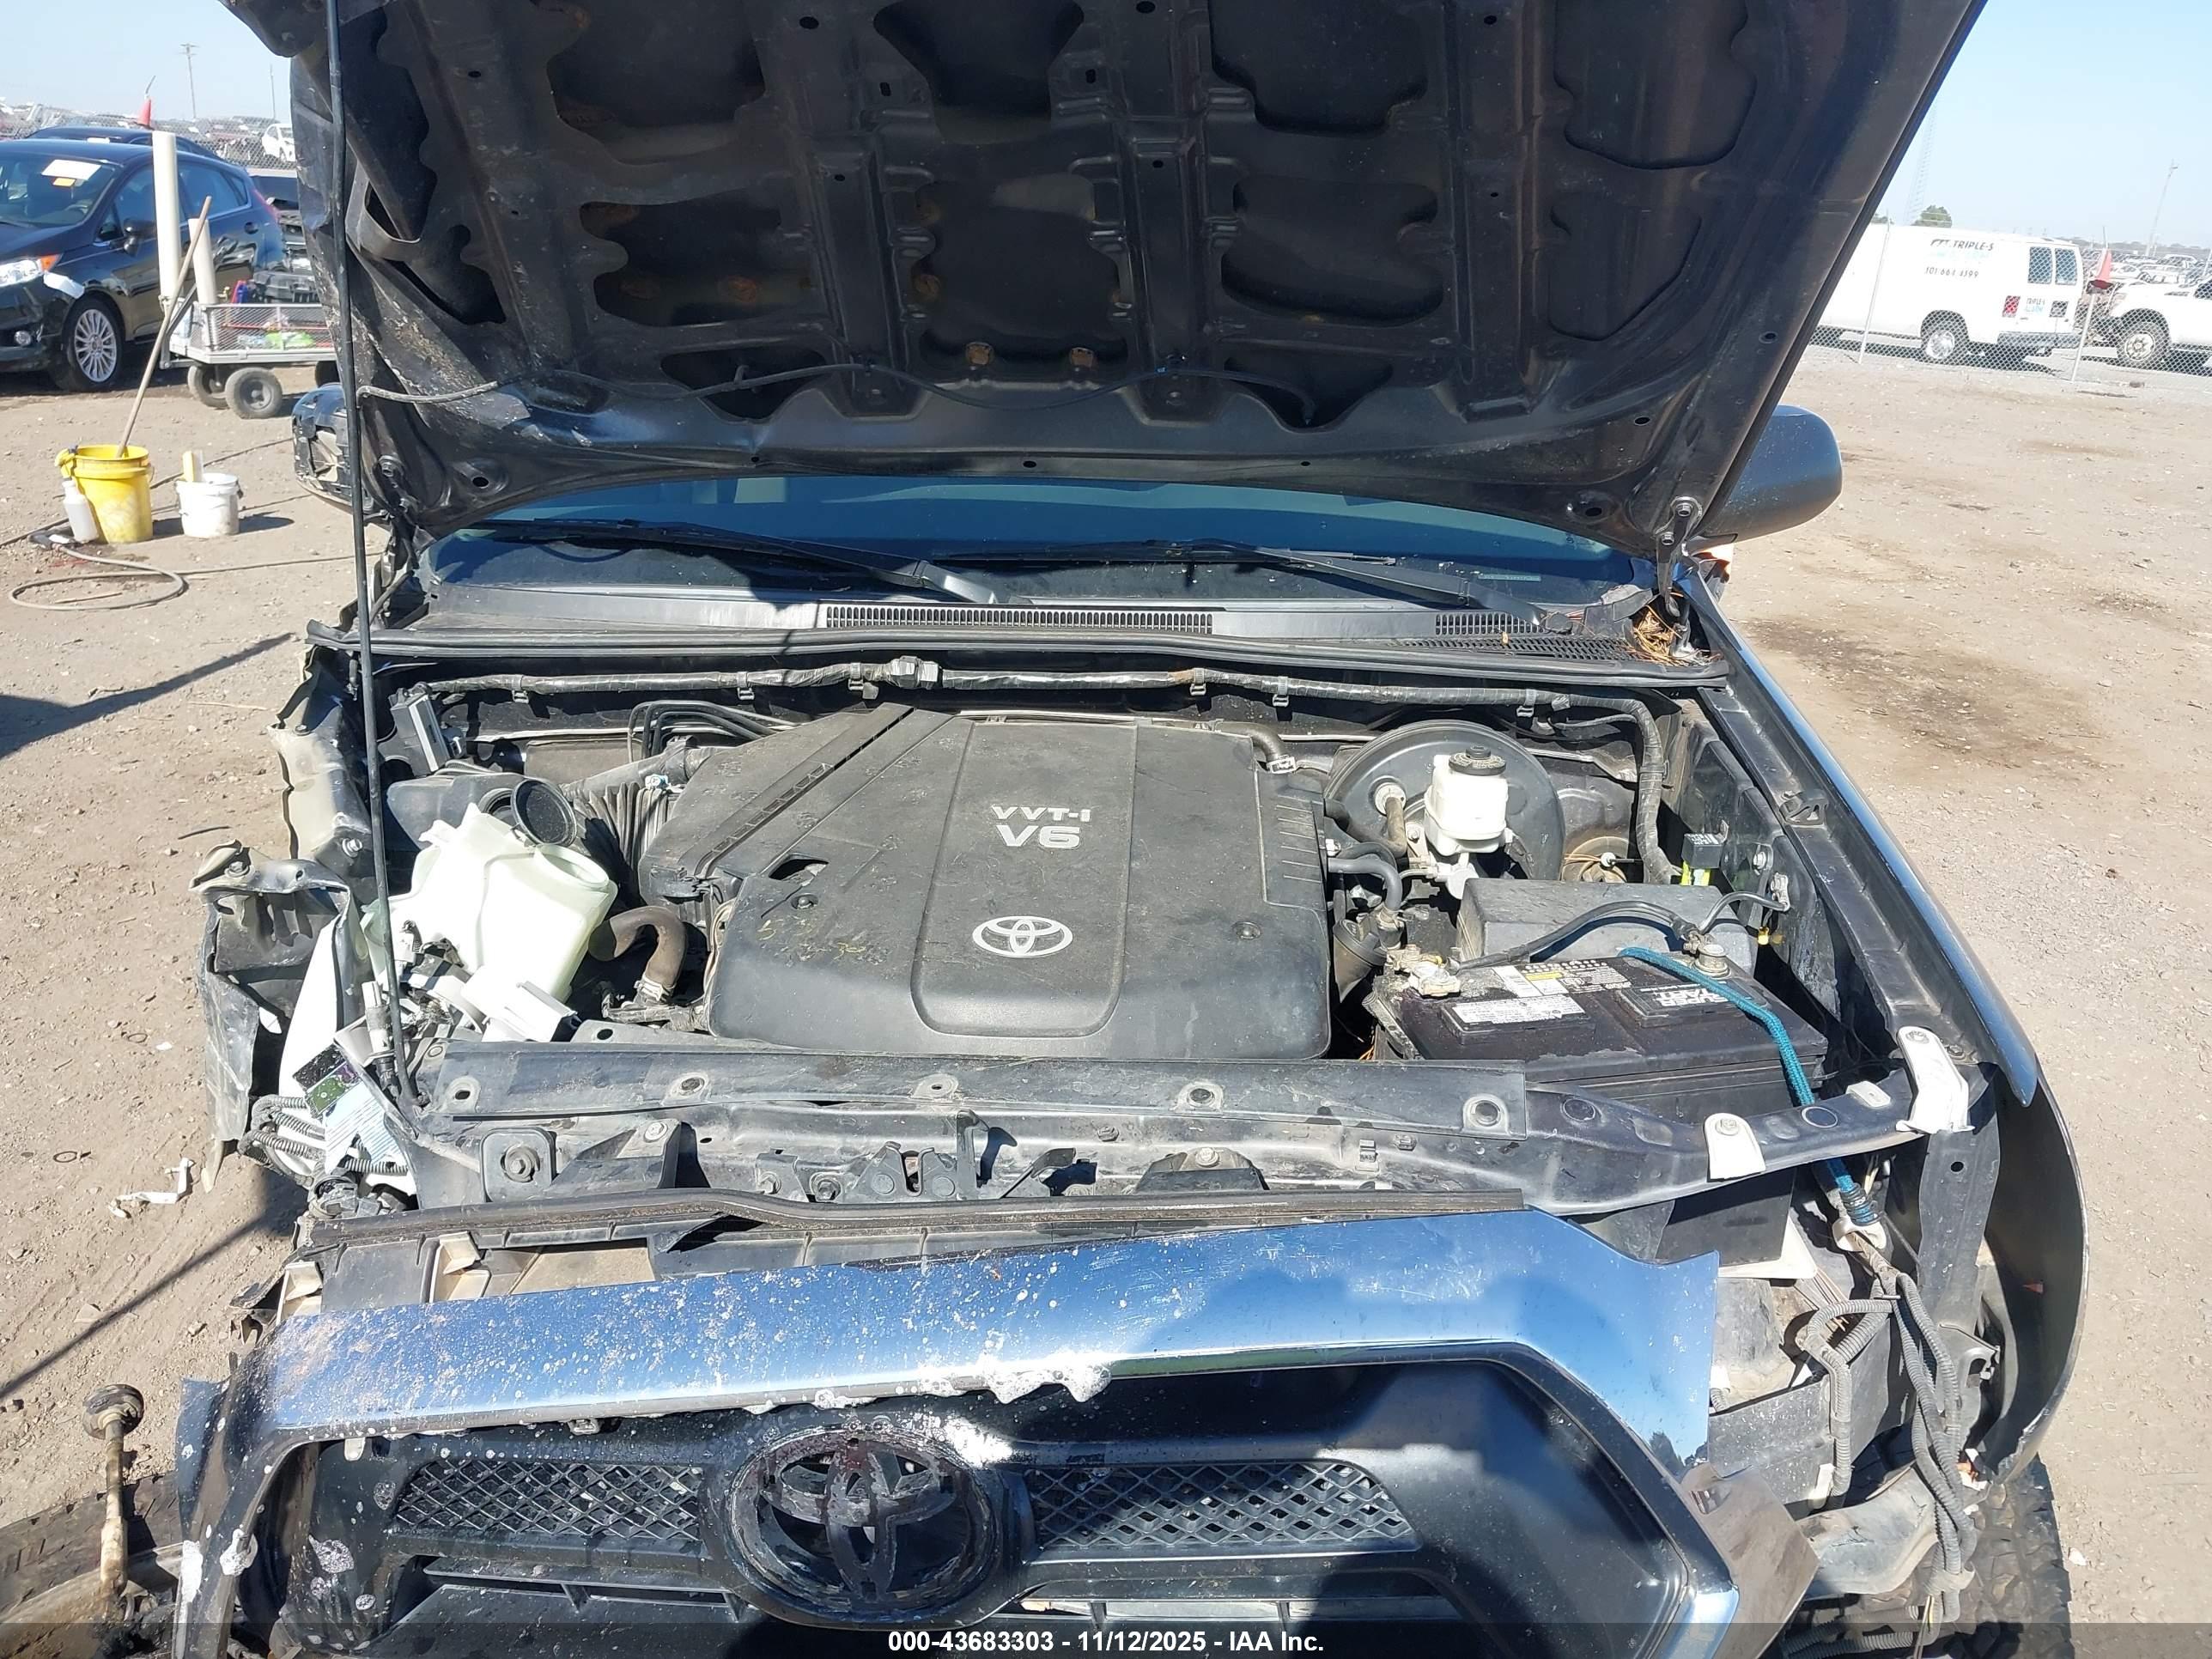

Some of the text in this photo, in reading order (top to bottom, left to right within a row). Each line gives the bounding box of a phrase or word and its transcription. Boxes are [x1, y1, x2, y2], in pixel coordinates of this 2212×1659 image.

[1953, 240, 1995, 252] TRIPLE-S
[995, 824, 1081, 849] V6
[1654, 988, 1720, 1000] TART
